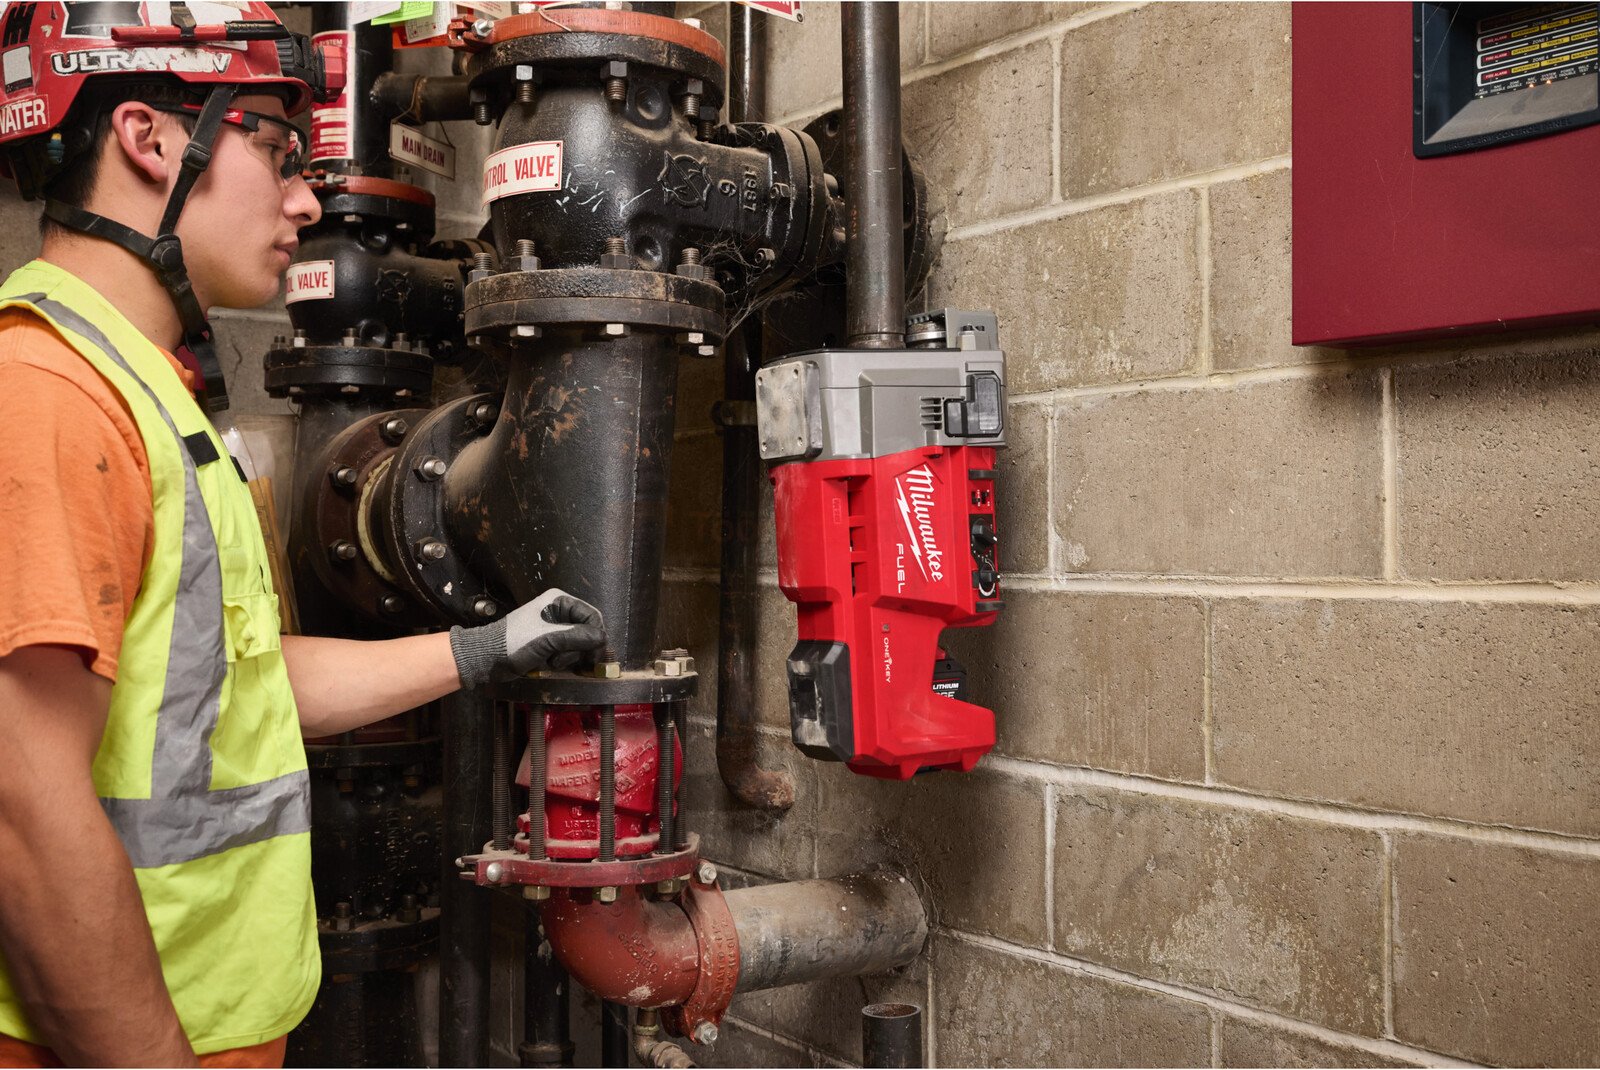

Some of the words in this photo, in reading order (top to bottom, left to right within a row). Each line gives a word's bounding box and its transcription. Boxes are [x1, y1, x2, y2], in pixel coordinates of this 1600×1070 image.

[402, 134, 422, 158] MAIN
[423, 144, 445, 168] DRAIN
[514, 155, 554, 180] VALVE
[298, 272, 329, 290] VALVE
[905, 464, 943, 582] Milwaukee
[896, 543, 905, 593] FUEL
[559, 750, 598, 768] MODEL
